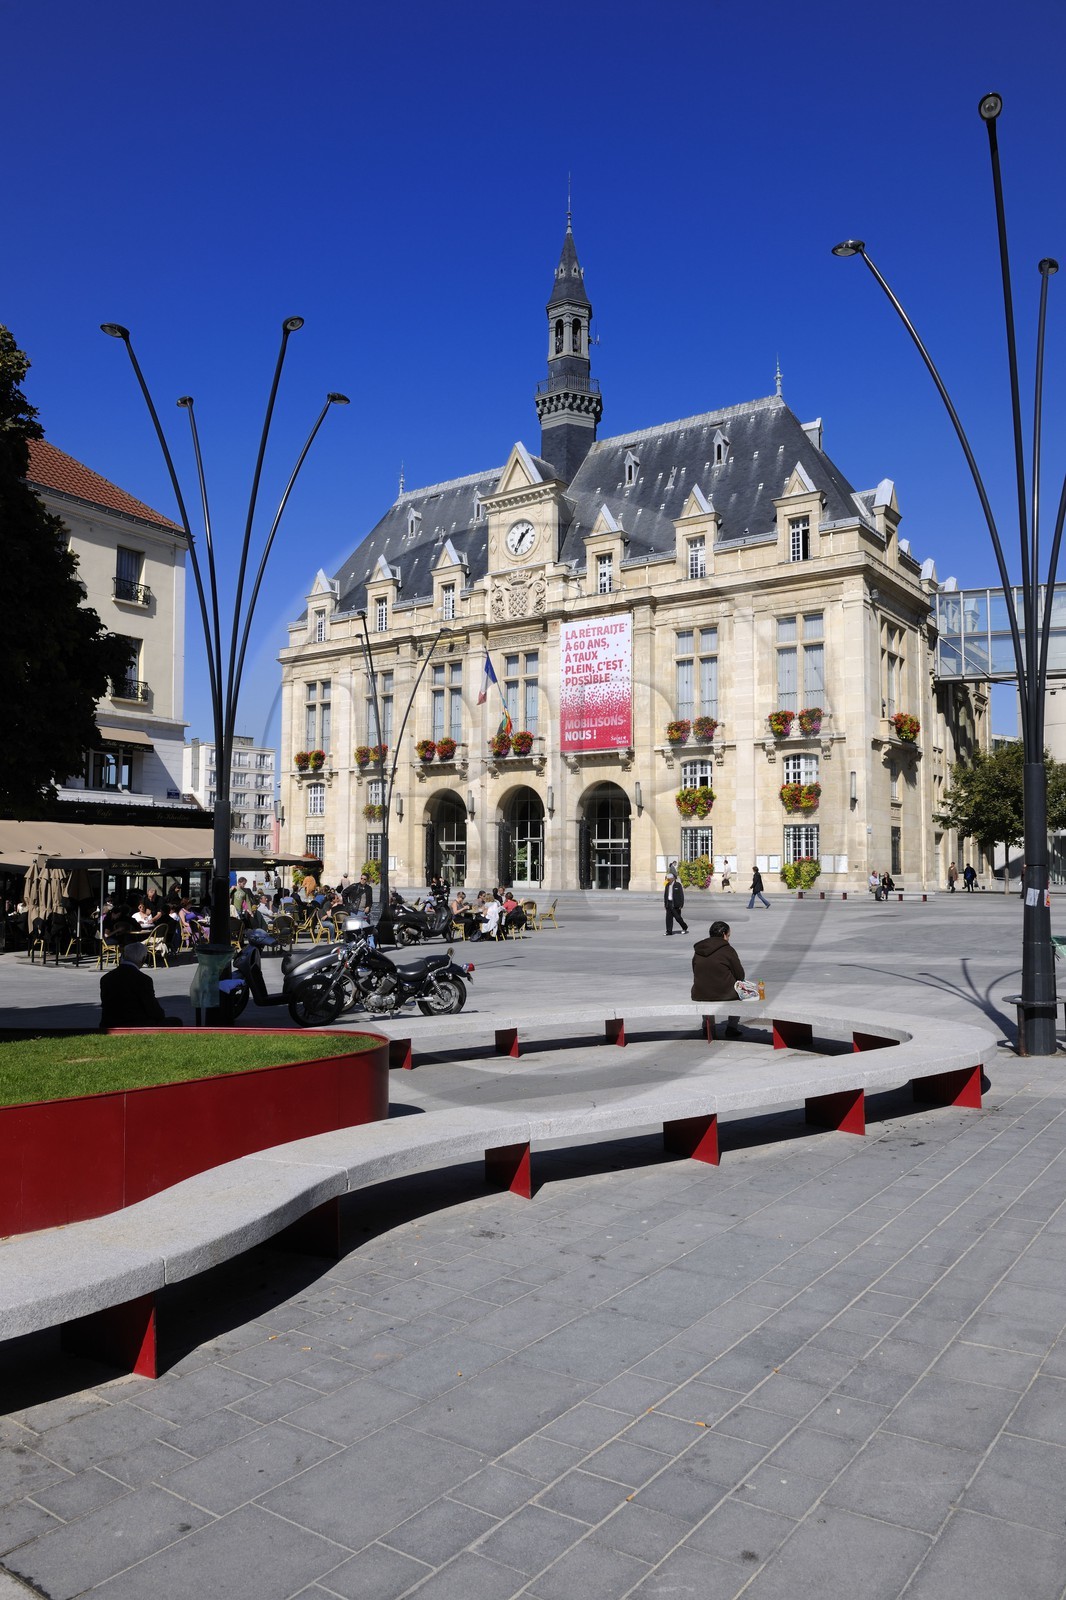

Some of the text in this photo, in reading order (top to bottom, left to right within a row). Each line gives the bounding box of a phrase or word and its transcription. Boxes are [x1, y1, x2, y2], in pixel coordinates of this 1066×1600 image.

[565, 623, 625, 640] LA RETRAITE
[565, 637, 610, 652] À 60 ANS,
[565, 650, 598, 663] À TAUX
[565, 659, 624, 675] PLEIN, C'EST
[565, 673, 610, 686] POSSIBLE
[565, 716, 626, 730] MOBILISONS-
[565, 730, 591, 741] NOUS
